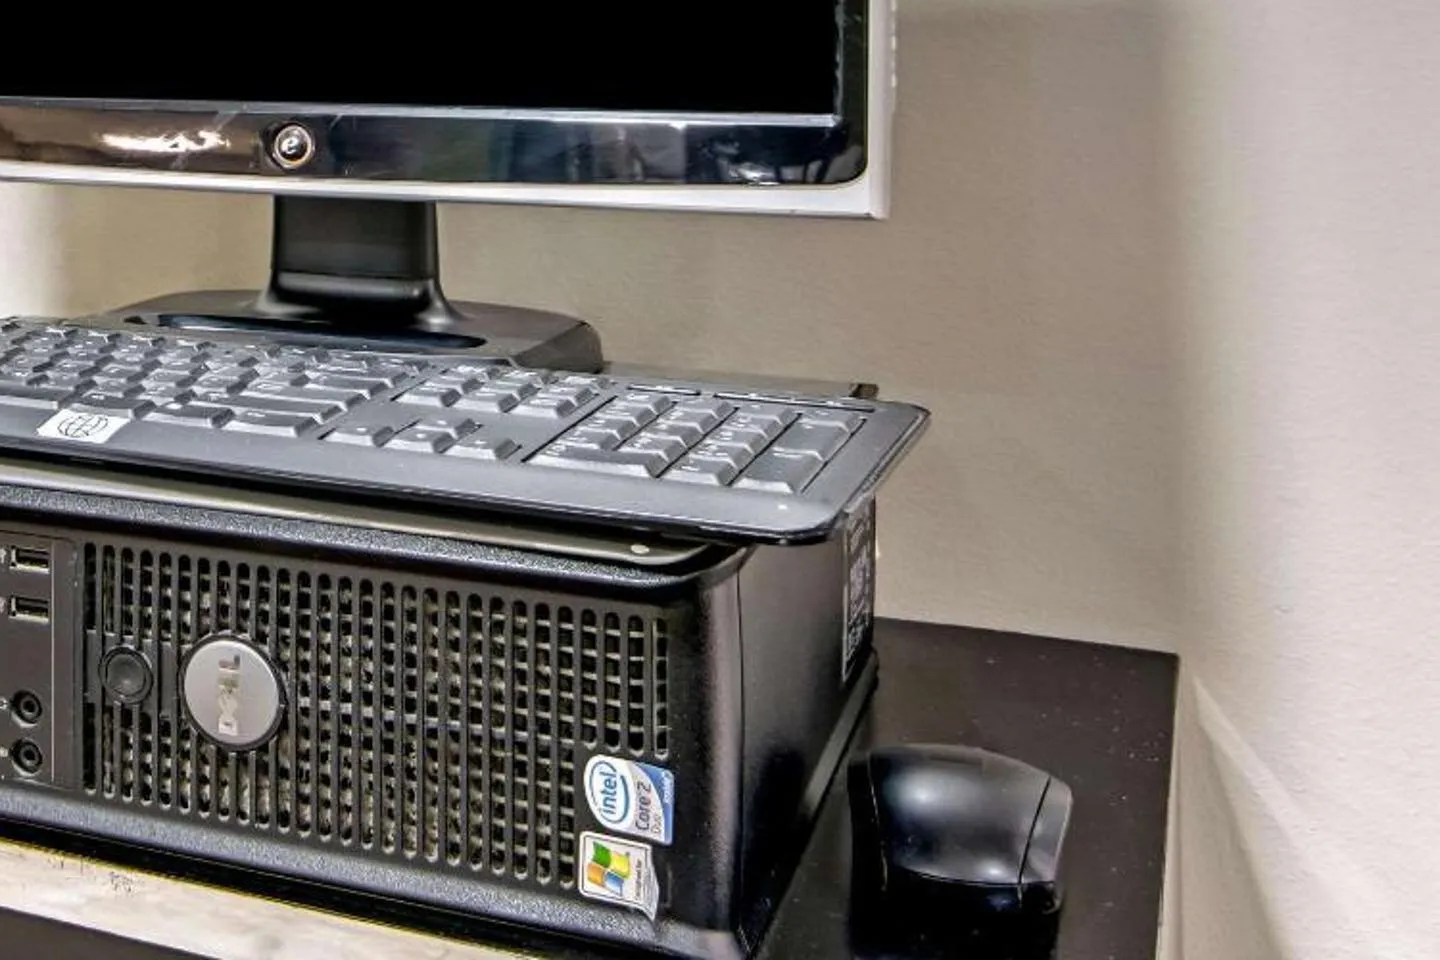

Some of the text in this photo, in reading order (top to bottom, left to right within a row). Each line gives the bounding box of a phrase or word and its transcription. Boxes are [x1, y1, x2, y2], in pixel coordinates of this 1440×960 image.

[600, 770, 618, 815] intel
[635, 781, 652, 831] Core 2
